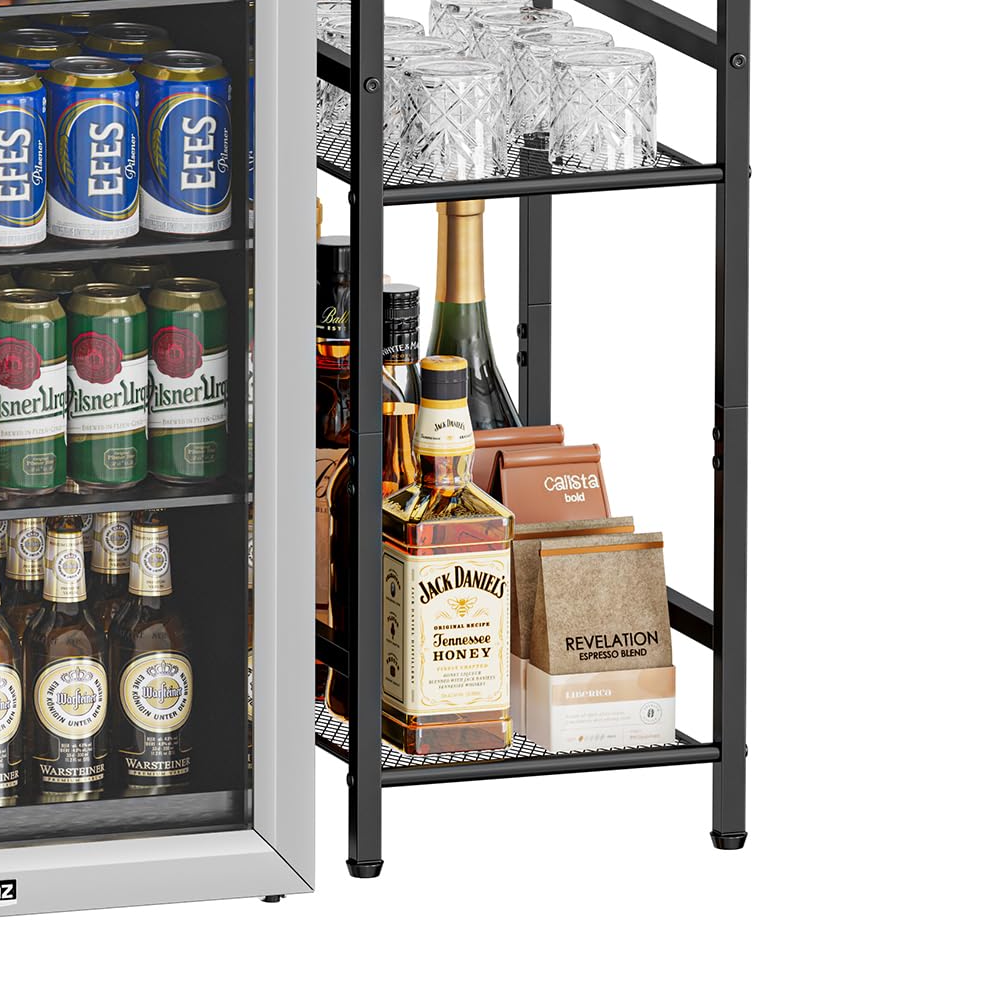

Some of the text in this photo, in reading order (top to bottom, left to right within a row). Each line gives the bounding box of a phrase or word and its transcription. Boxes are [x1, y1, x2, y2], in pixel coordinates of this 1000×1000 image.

[124, 132, 136, 180] Pilsener
[180, 115, 218, 192] EFES
[217, 127, 229, 174] Pilsener
[32, 139, 43, 186] Pilsener
[87, 120, 125, 198] EFES
[564, 492, 585, 503] bold
[418, 565, 506, 605] JACK DANIEL'S
[433, 632, 491, 648] Tennessee
[565, 630, 659, 651] REVELATION
[433, 647, 491, 661] HONEY
[579, 648, 648, 661] ESPRESSO BLEND
[46, 680, 60, 696] EINE
[132, 674, 145, 690] EINE
[56, 688, 97, 711] Warsteiner
[142, 681, 183, 704] Warsteiner
[46, 698, 66, 723] KÖNIGIN
[92, 705, 101, 718] DEN
[131, 691, 151, 717] KÖNIGIN
[178, 698, 187, 712] DEN
[6, 711, 15, 725] DEN
[67, 717, 92, 727] UNTER
[153, 711, 178, 720] UNTER
[39, 763, 105, 776] WARSTEINER
[125, 757, 191, 770] WARSTEINER
